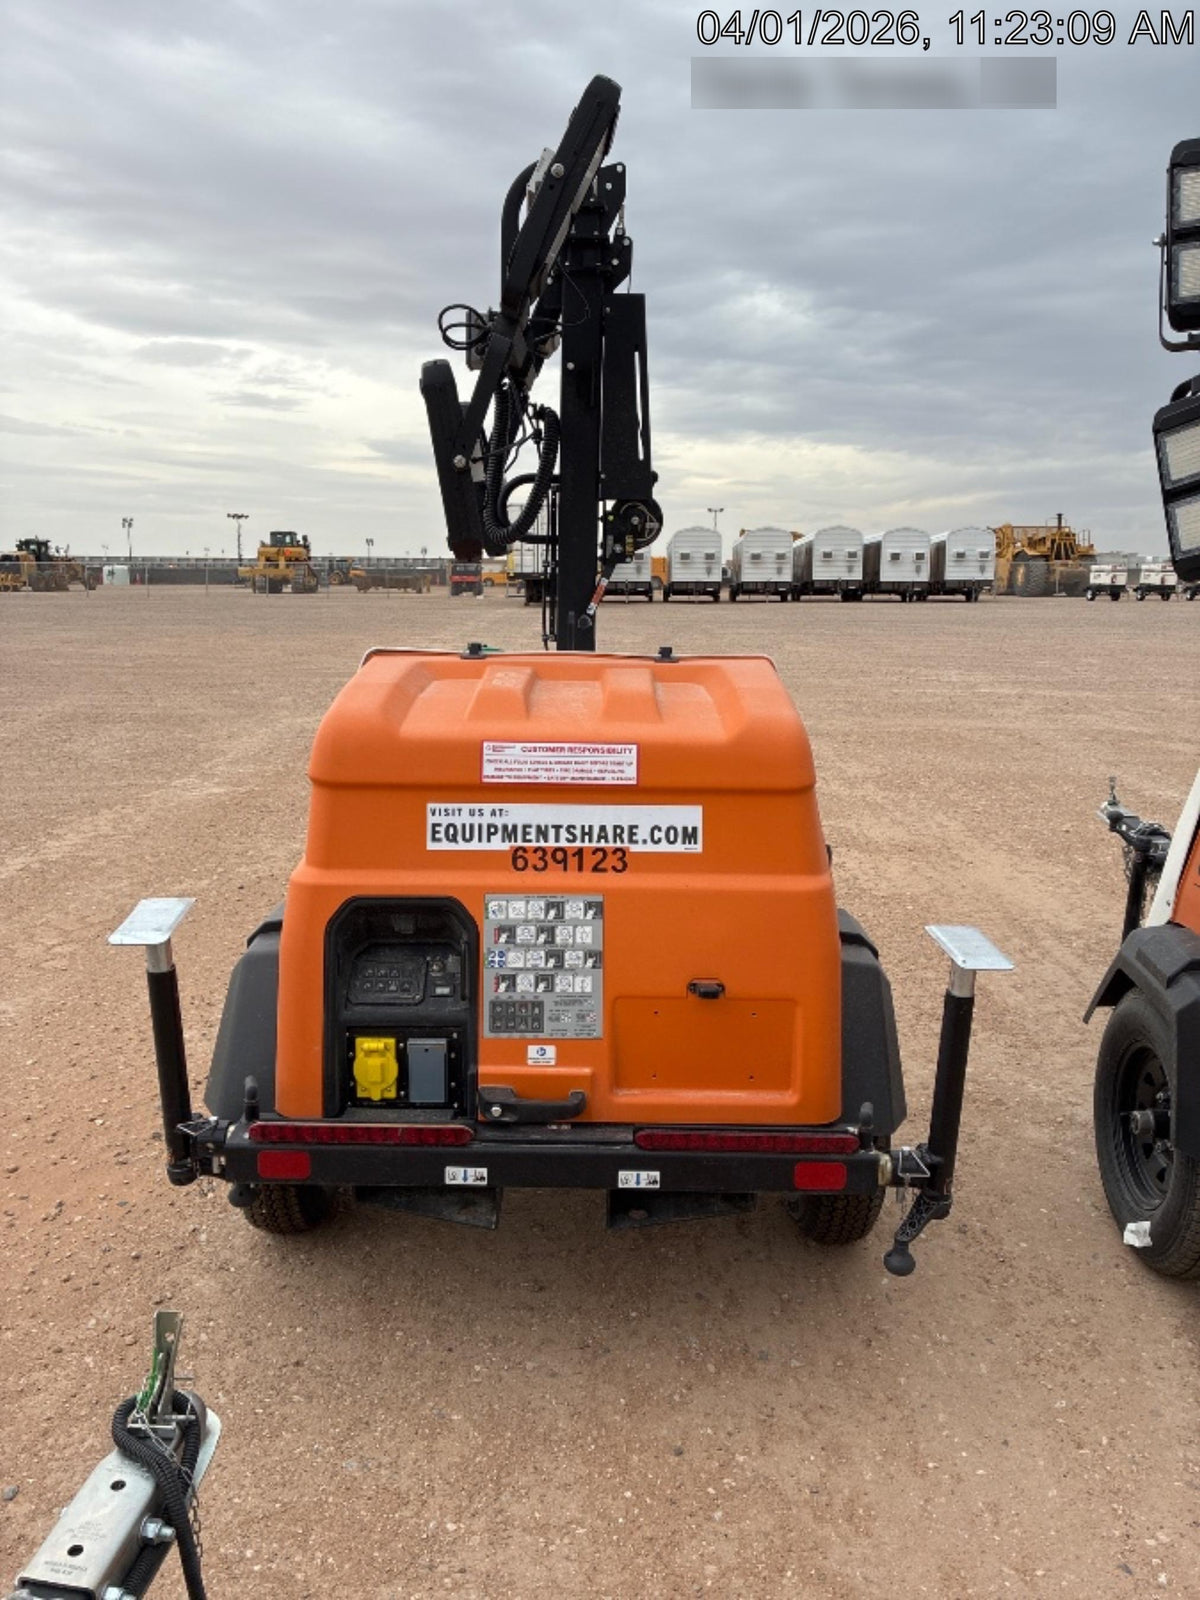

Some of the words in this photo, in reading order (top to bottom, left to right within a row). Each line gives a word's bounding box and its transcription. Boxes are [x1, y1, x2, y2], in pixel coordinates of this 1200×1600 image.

[520, 746, 566, 754] CUSTOMER
[567, 746, 633, 755] RESPONSIBILITY
[430, 807, 463, 817] VISIT
[468, 808, 484, 818] US
[490, 808, 510, 818] AT:
[430, 822, 699, 845] EQUIPMENTSHARE.COM
[511, 846, 628, 873] 639123
